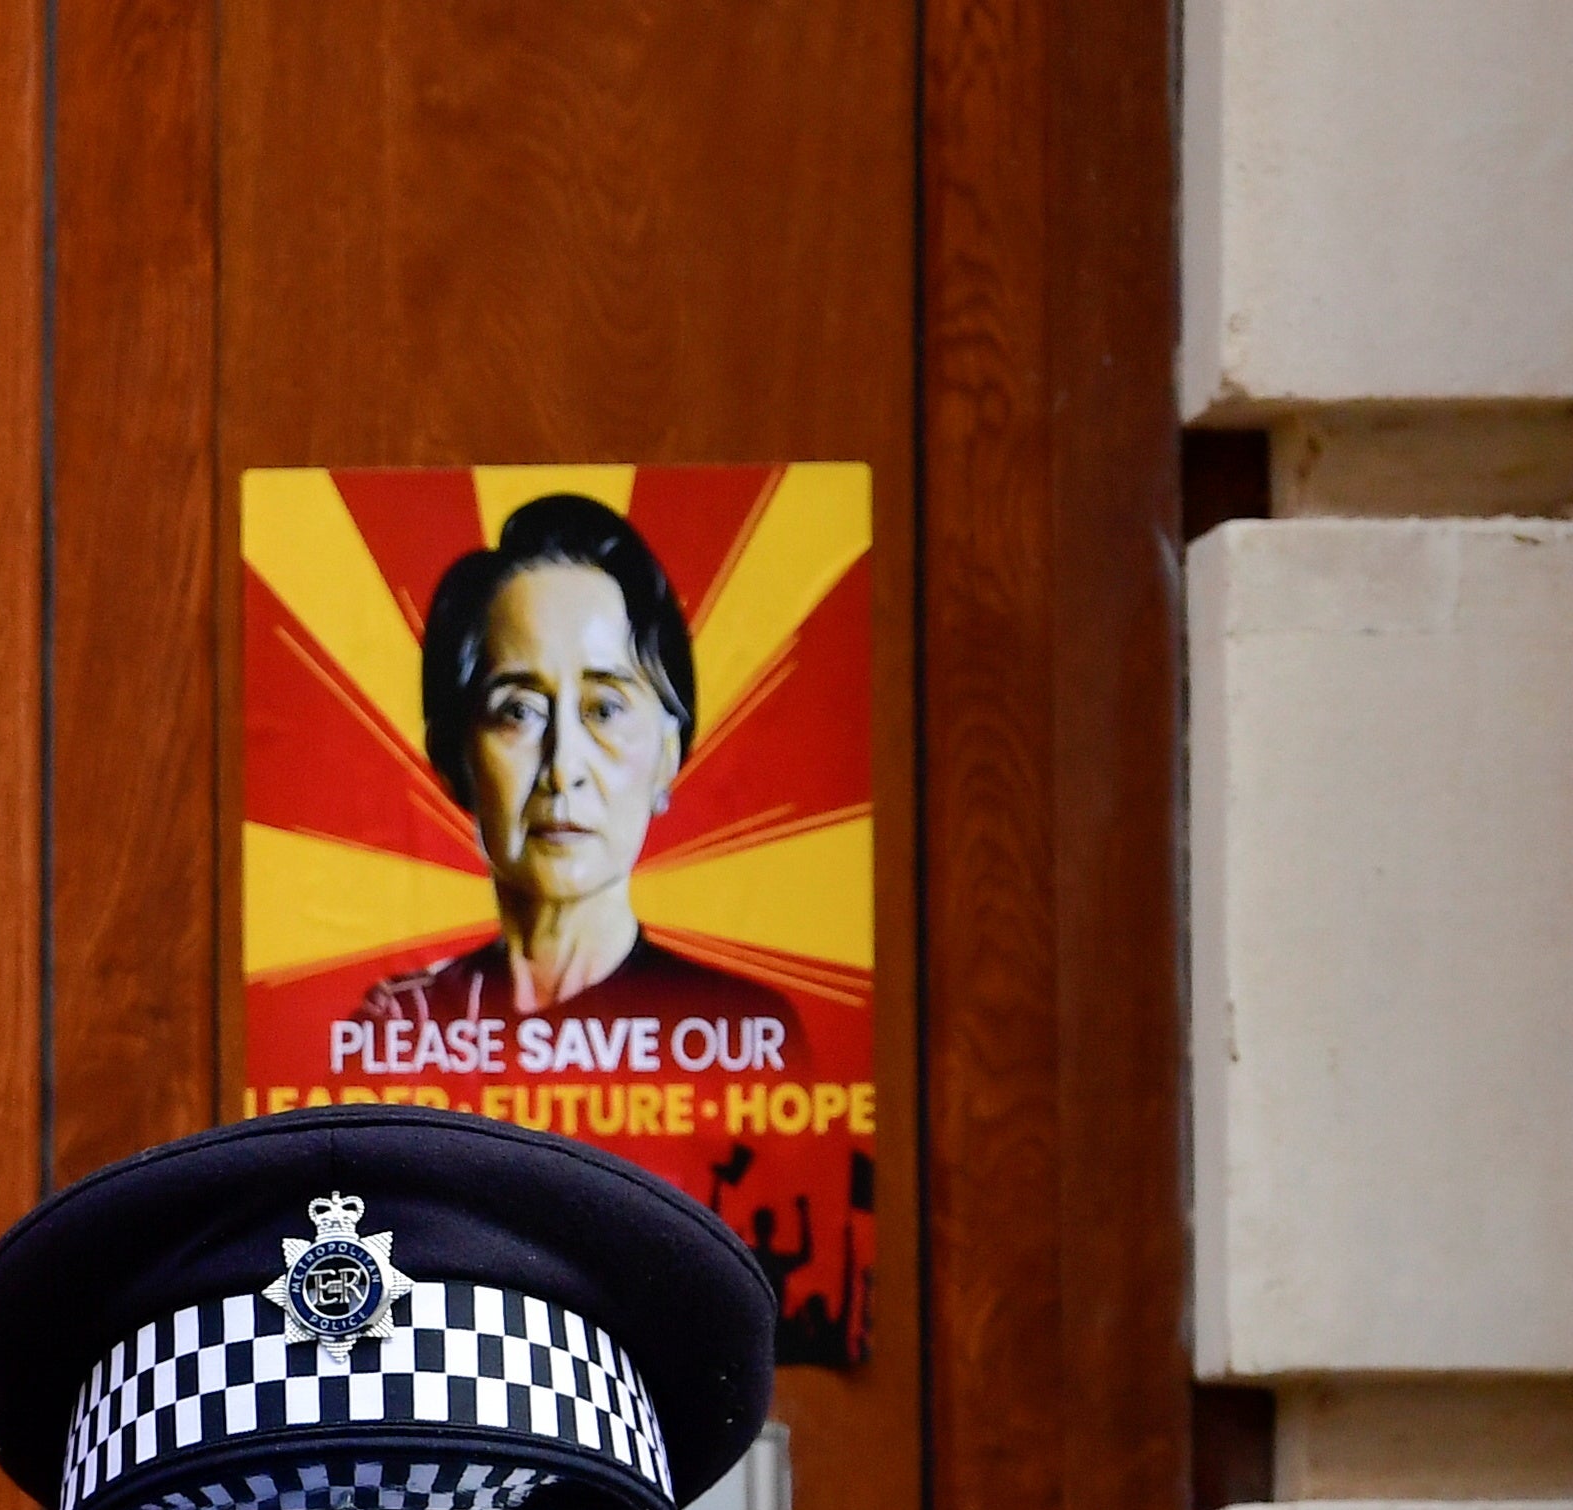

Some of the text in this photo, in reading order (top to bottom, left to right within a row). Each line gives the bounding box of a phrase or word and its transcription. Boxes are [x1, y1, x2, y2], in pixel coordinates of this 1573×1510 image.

[329, 1016, 785, 1074] PLEASE SAVE OUR
[292, 1243, 381, 1293] METROPOLITAN
[310, 1312, 368, 1331] POLICE
